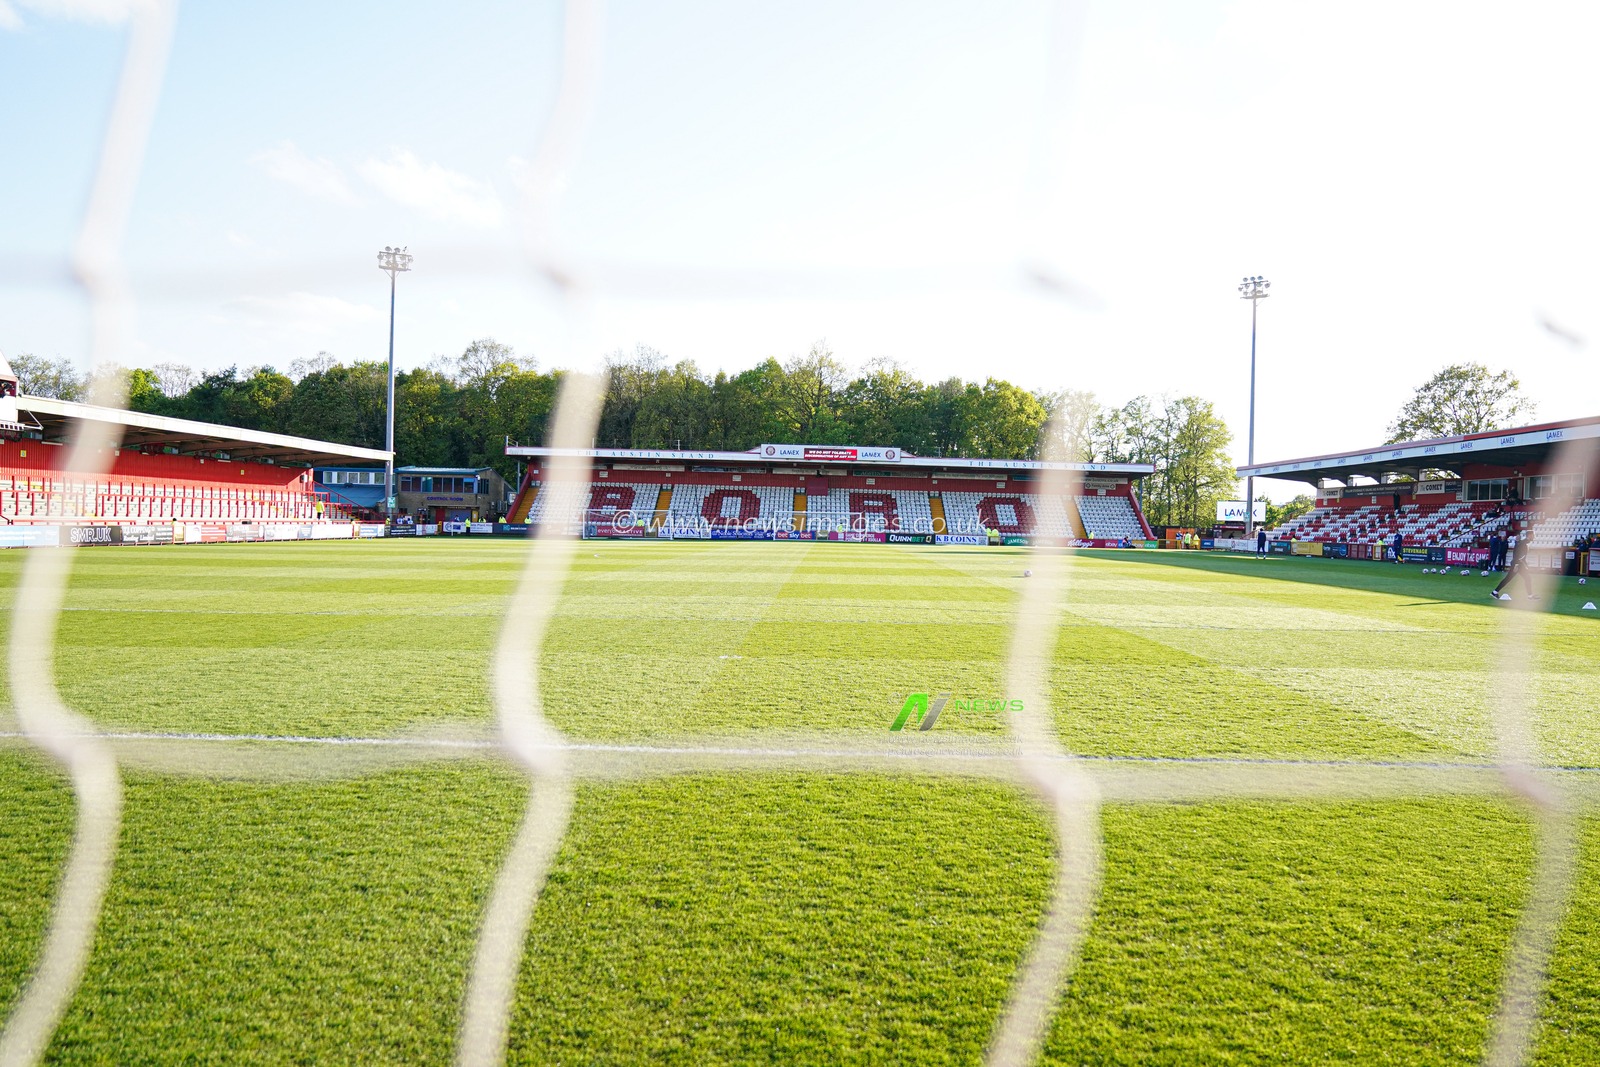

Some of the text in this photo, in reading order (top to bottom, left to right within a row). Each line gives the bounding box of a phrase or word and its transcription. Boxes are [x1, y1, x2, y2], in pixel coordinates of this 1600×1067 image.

[1546, 431, 1563, 440] LAMEX
[1500, 437, 1515, 445] LAMEX
[1425, 483, 1443, 491] COMET
[70, 526, 112, 543] SMR.UK
[1452, 552, 1466, 562] ENJOY
